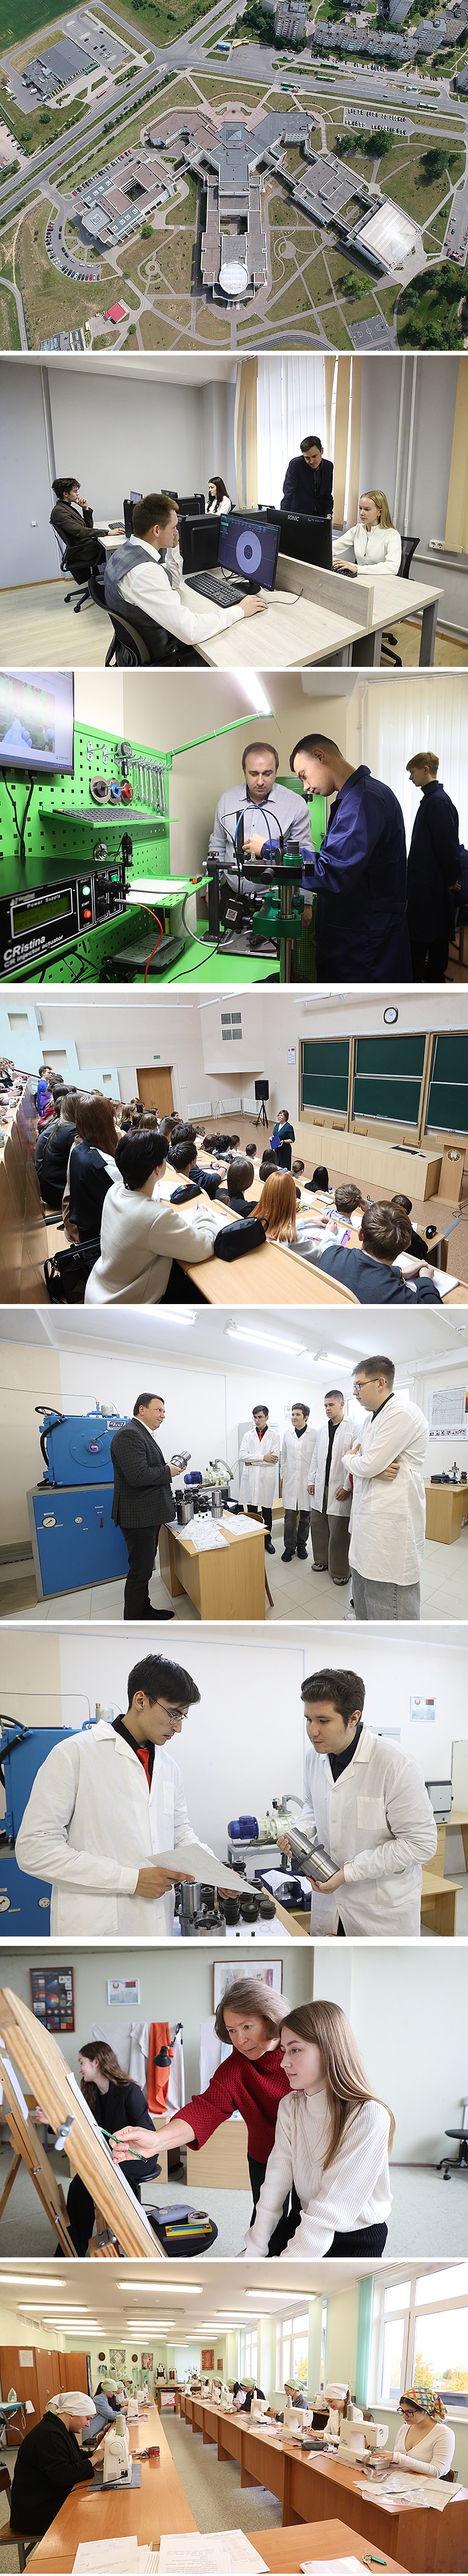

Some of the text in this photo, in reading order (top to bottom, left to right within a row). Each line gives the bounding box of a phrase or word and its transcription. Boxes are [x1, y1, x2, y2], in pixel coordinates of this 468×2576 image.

[26, 900, 43, 908] Power
[4, 936, 46, 962] CRistina
[4, 935, 63, 969] CR injector actuator
